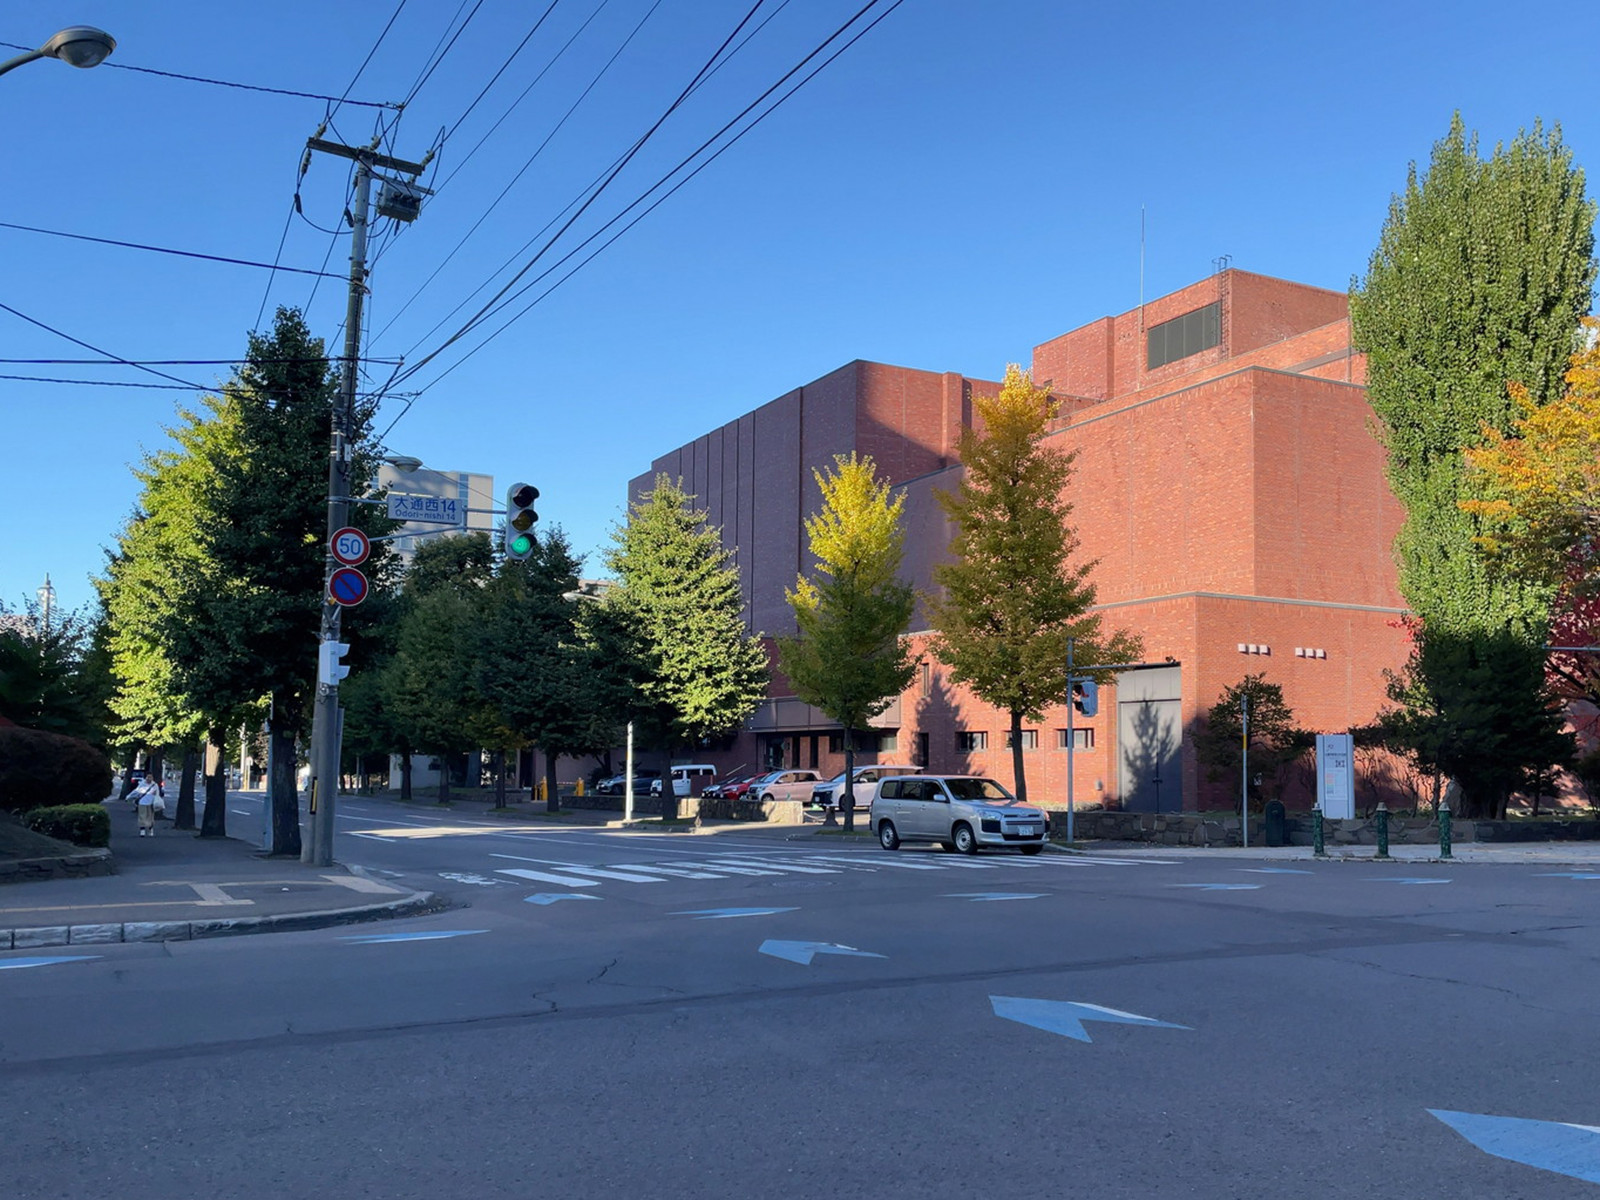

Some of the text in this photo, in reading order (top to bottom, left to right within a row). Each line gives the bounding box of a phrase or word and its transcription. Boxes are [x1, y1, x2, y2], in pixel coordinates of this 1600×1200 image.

[395, 496, 456, 513] 大通西14
[395, 509, 444, 520] Odori-nishi
[339, 537, 361, 556] 50
